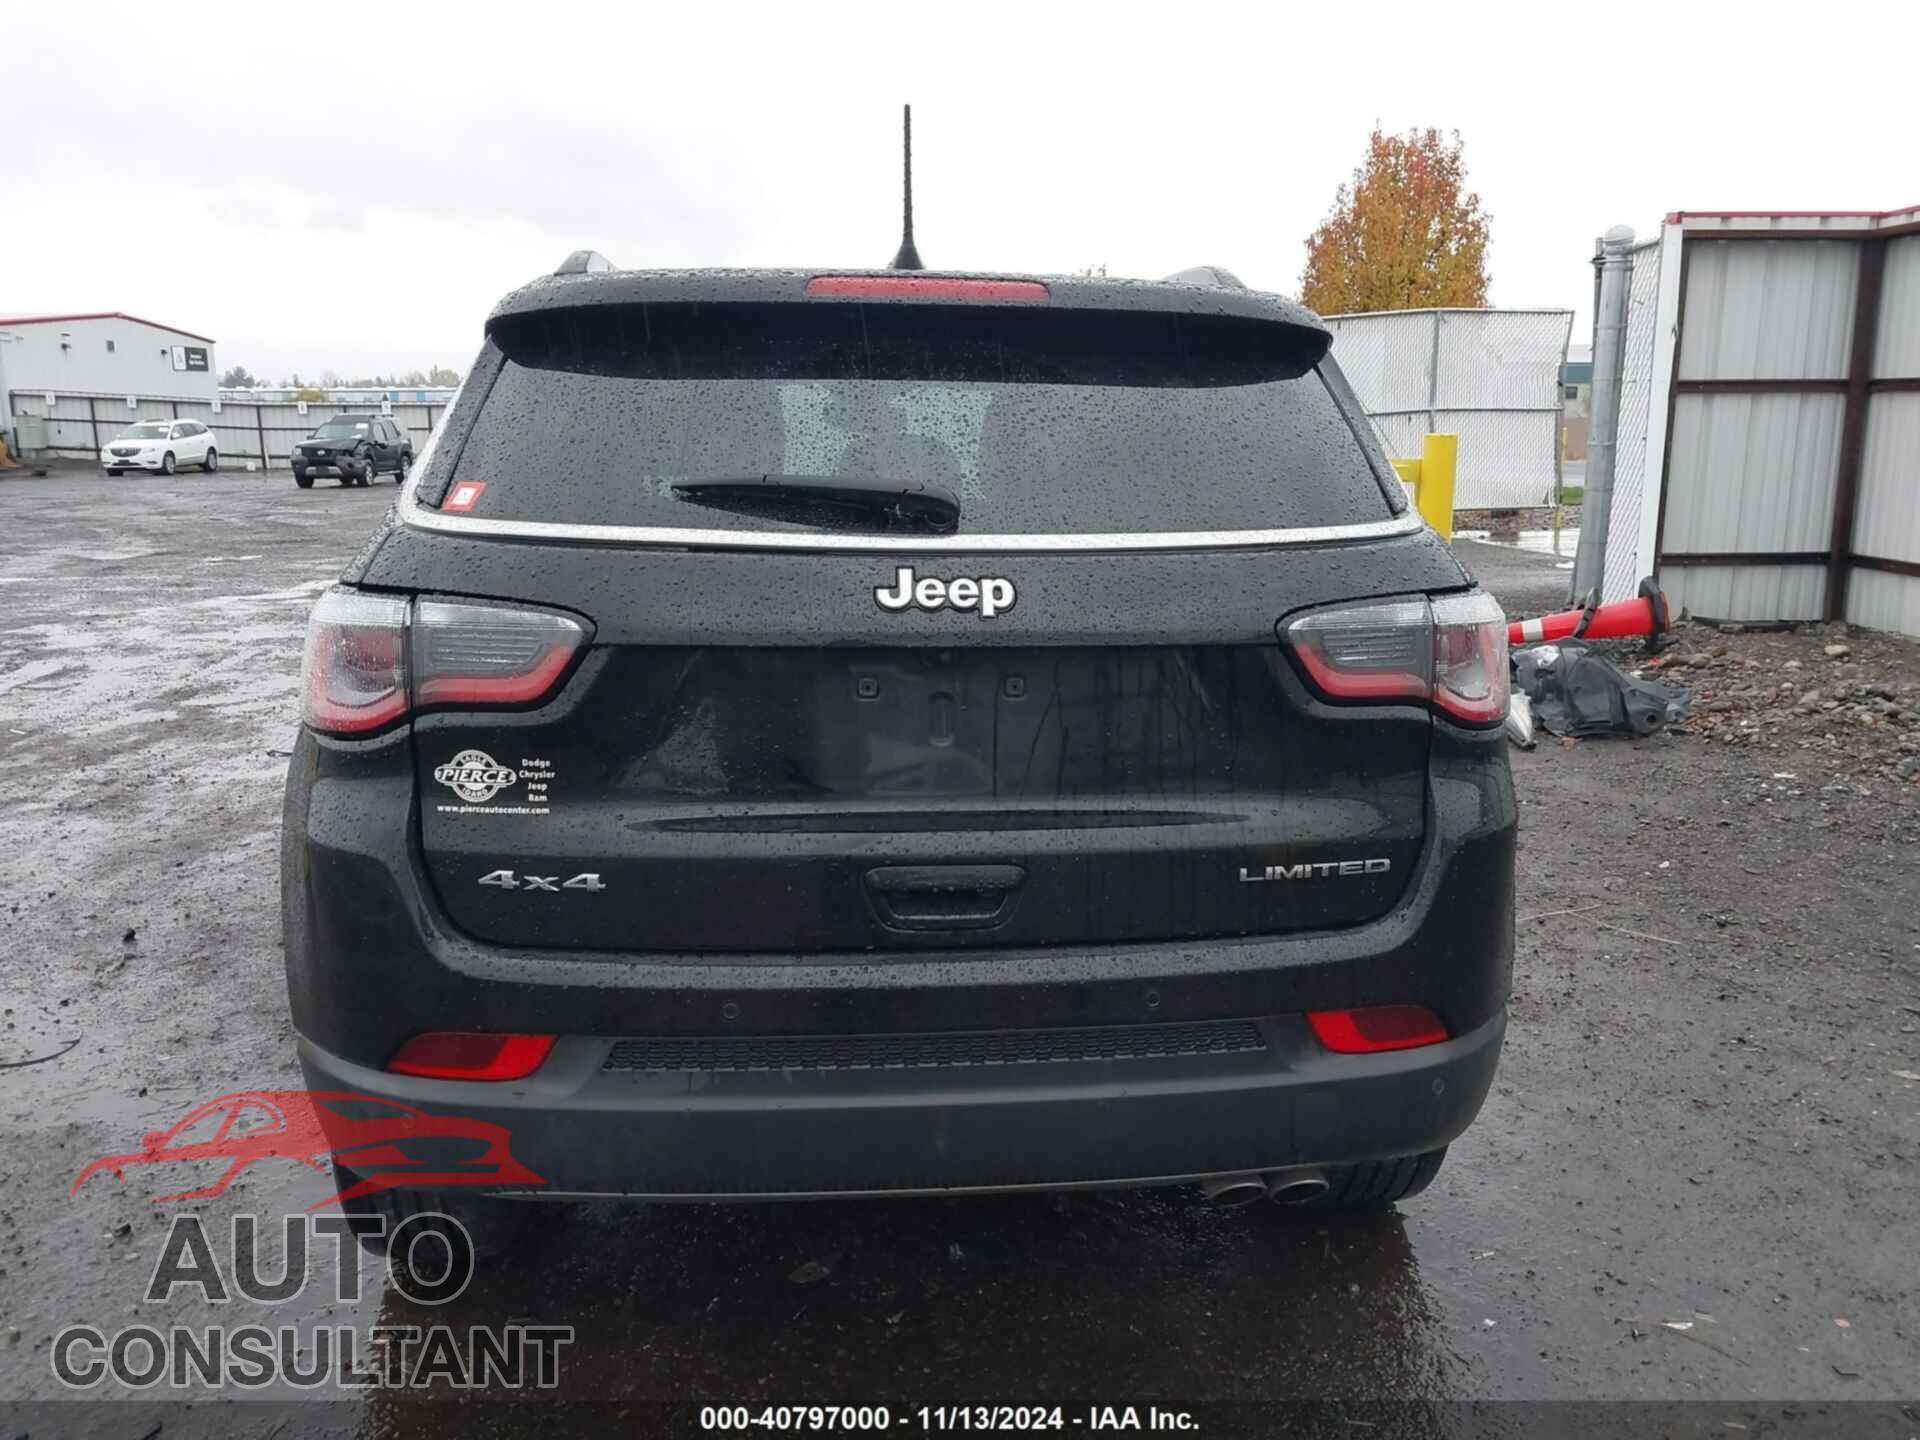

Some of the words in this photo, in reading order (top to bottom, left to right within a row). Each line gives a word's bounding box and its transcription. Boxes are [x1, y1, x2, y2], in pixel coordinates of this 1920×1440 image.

[876, 567, 1016, 617] Jeep
[521, 758, 551, 768] Dodge
[441, 769, 507, 783] PIERCE
[519, 770, 556, 780] Chrysler
[528, 782, 548, 791] Jeep
[437, 804, 550, 815] www.pierceautocenter.com
[1239, 857, 1391, 882] LIMITED
[478, 869, 606, 892] 4x4
